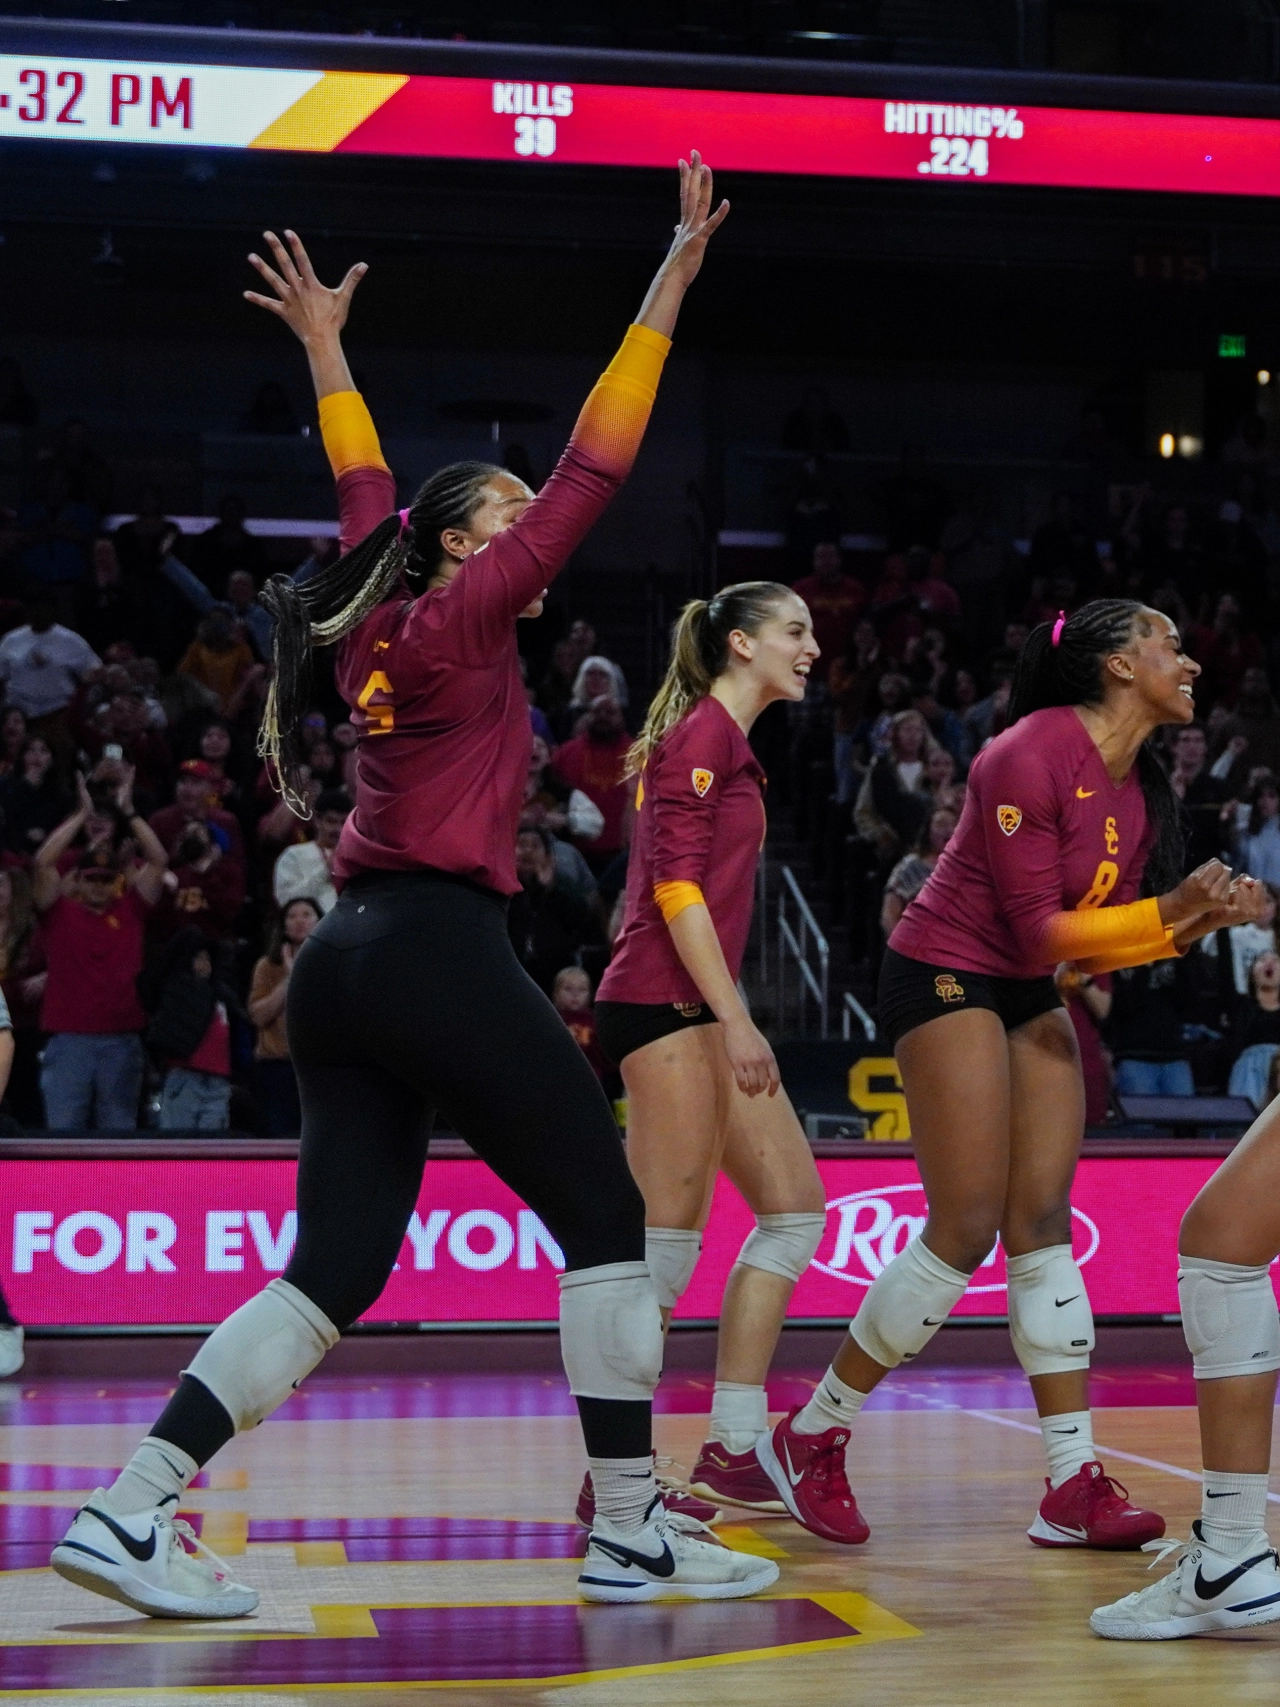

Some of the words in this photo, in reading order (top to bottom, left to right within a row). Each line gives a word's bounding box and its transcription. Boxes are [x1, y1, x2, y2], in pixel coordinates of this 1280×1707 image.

[111, 74, 192, 129] PM
[492, 82, 574, 117] KILLS
[884, 102, 1024, 139] HITTING%
[917, 137, 989, 176] .224
[1076, 860, 1119, 910] 8
[12, 1210, 177, 1274] FOR
[205, 1210, 567, 1273] EVYON
